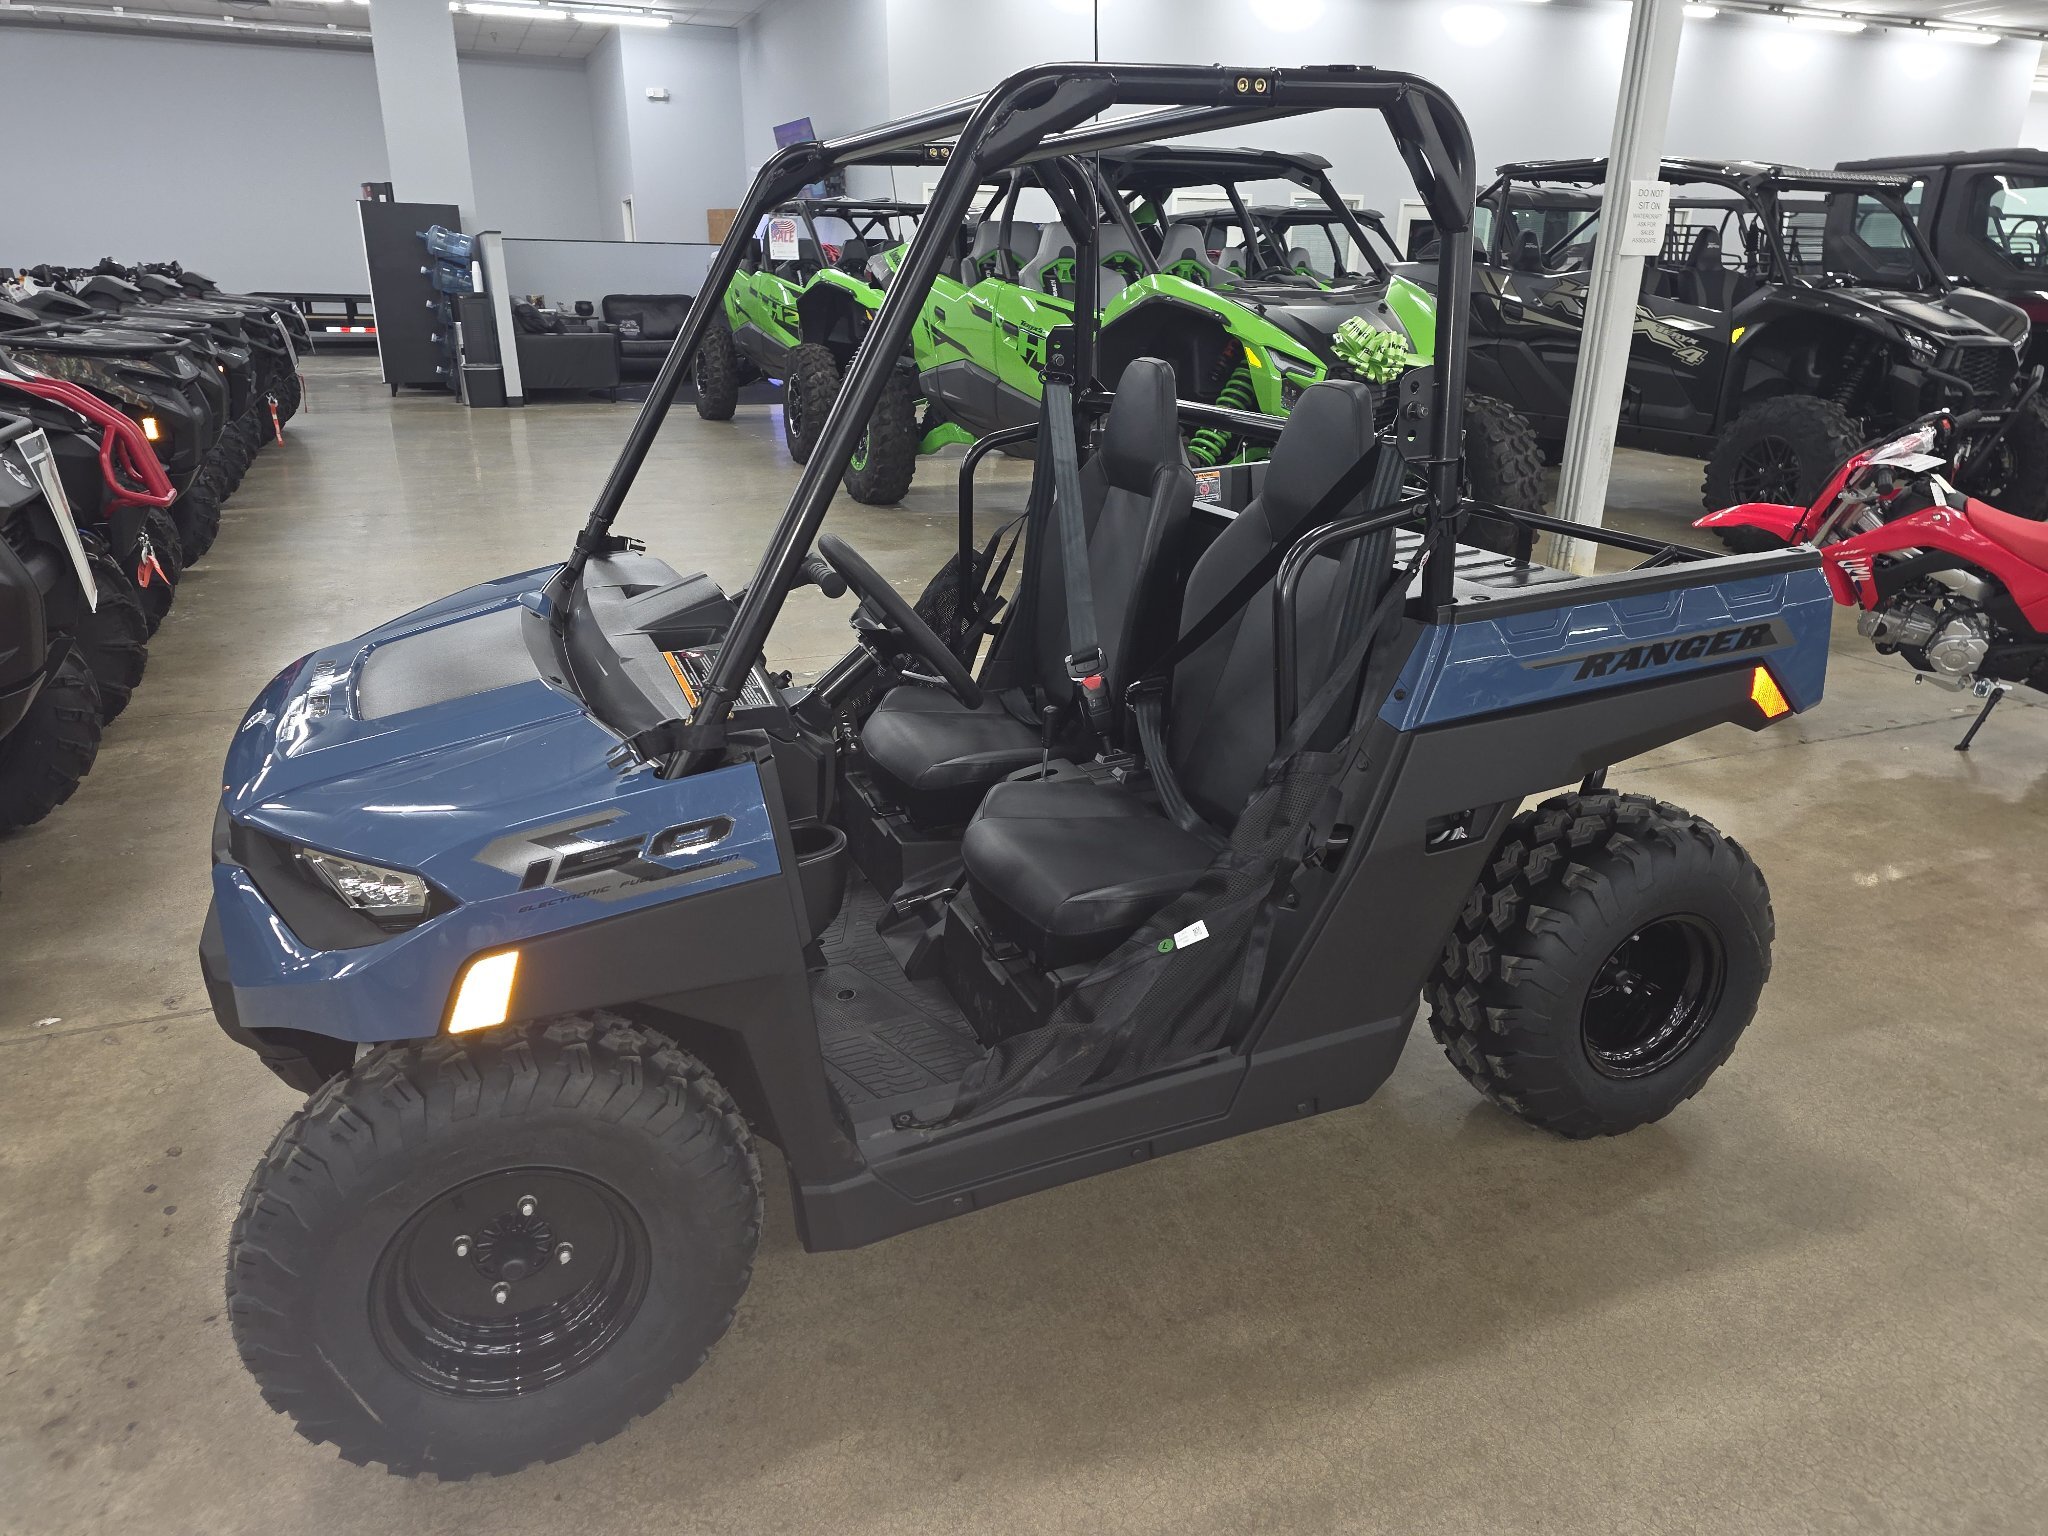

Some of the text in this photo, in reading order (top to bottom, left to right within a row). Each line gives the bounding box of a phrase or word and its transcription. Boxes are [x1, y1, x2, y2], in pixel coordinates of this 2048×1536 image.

[1638, 188, 1664, 198] DO NOT
[1638, 201, 1661, 210] SIT ON
[1671, 345, 1709, 367] 4
[1573, 622, 1778, 682] RANGER
[518, 884, 611, 914] ELECTRONIC
